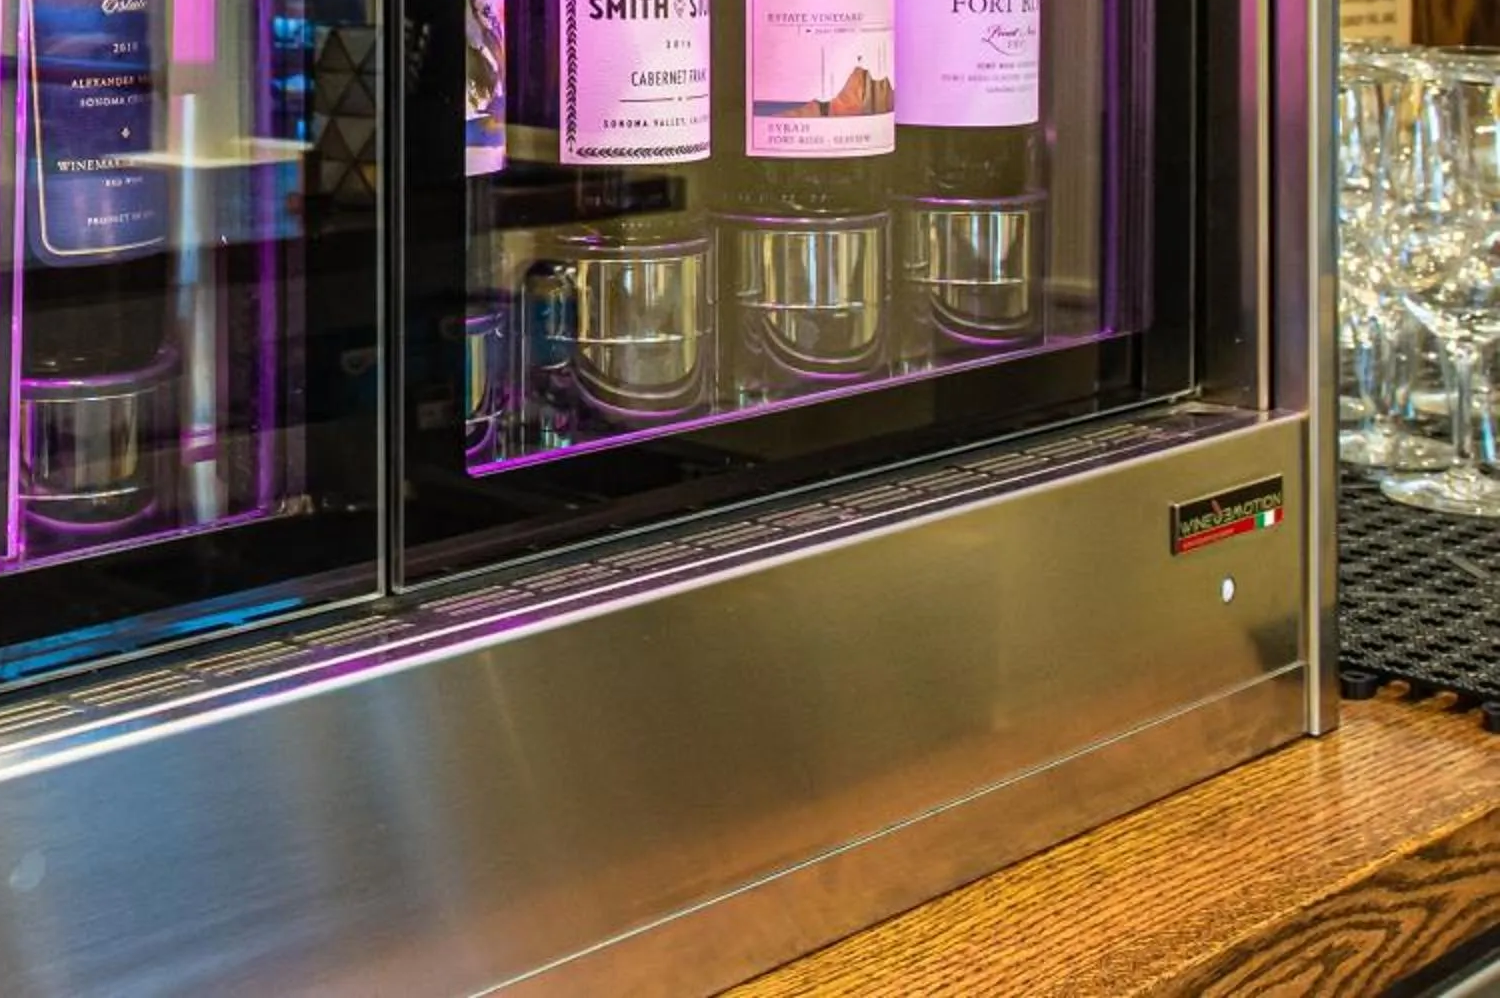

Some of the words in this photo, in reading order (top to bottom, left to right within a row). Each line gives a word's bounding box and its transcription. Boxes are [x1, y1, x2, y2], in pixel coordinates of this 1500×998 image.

[767, 12, 809, 23] ESTATE
[811, 12, 864, 23] VINEYARD
[71, 74, 135, 89] ALEXANDER
[631, 69, 687, 87] CABERNET
[80, 96, 125, 108] SONOMA
[603, 118, 649, 129] SONOMA
[767, 122, 811, 135] SYRAH
